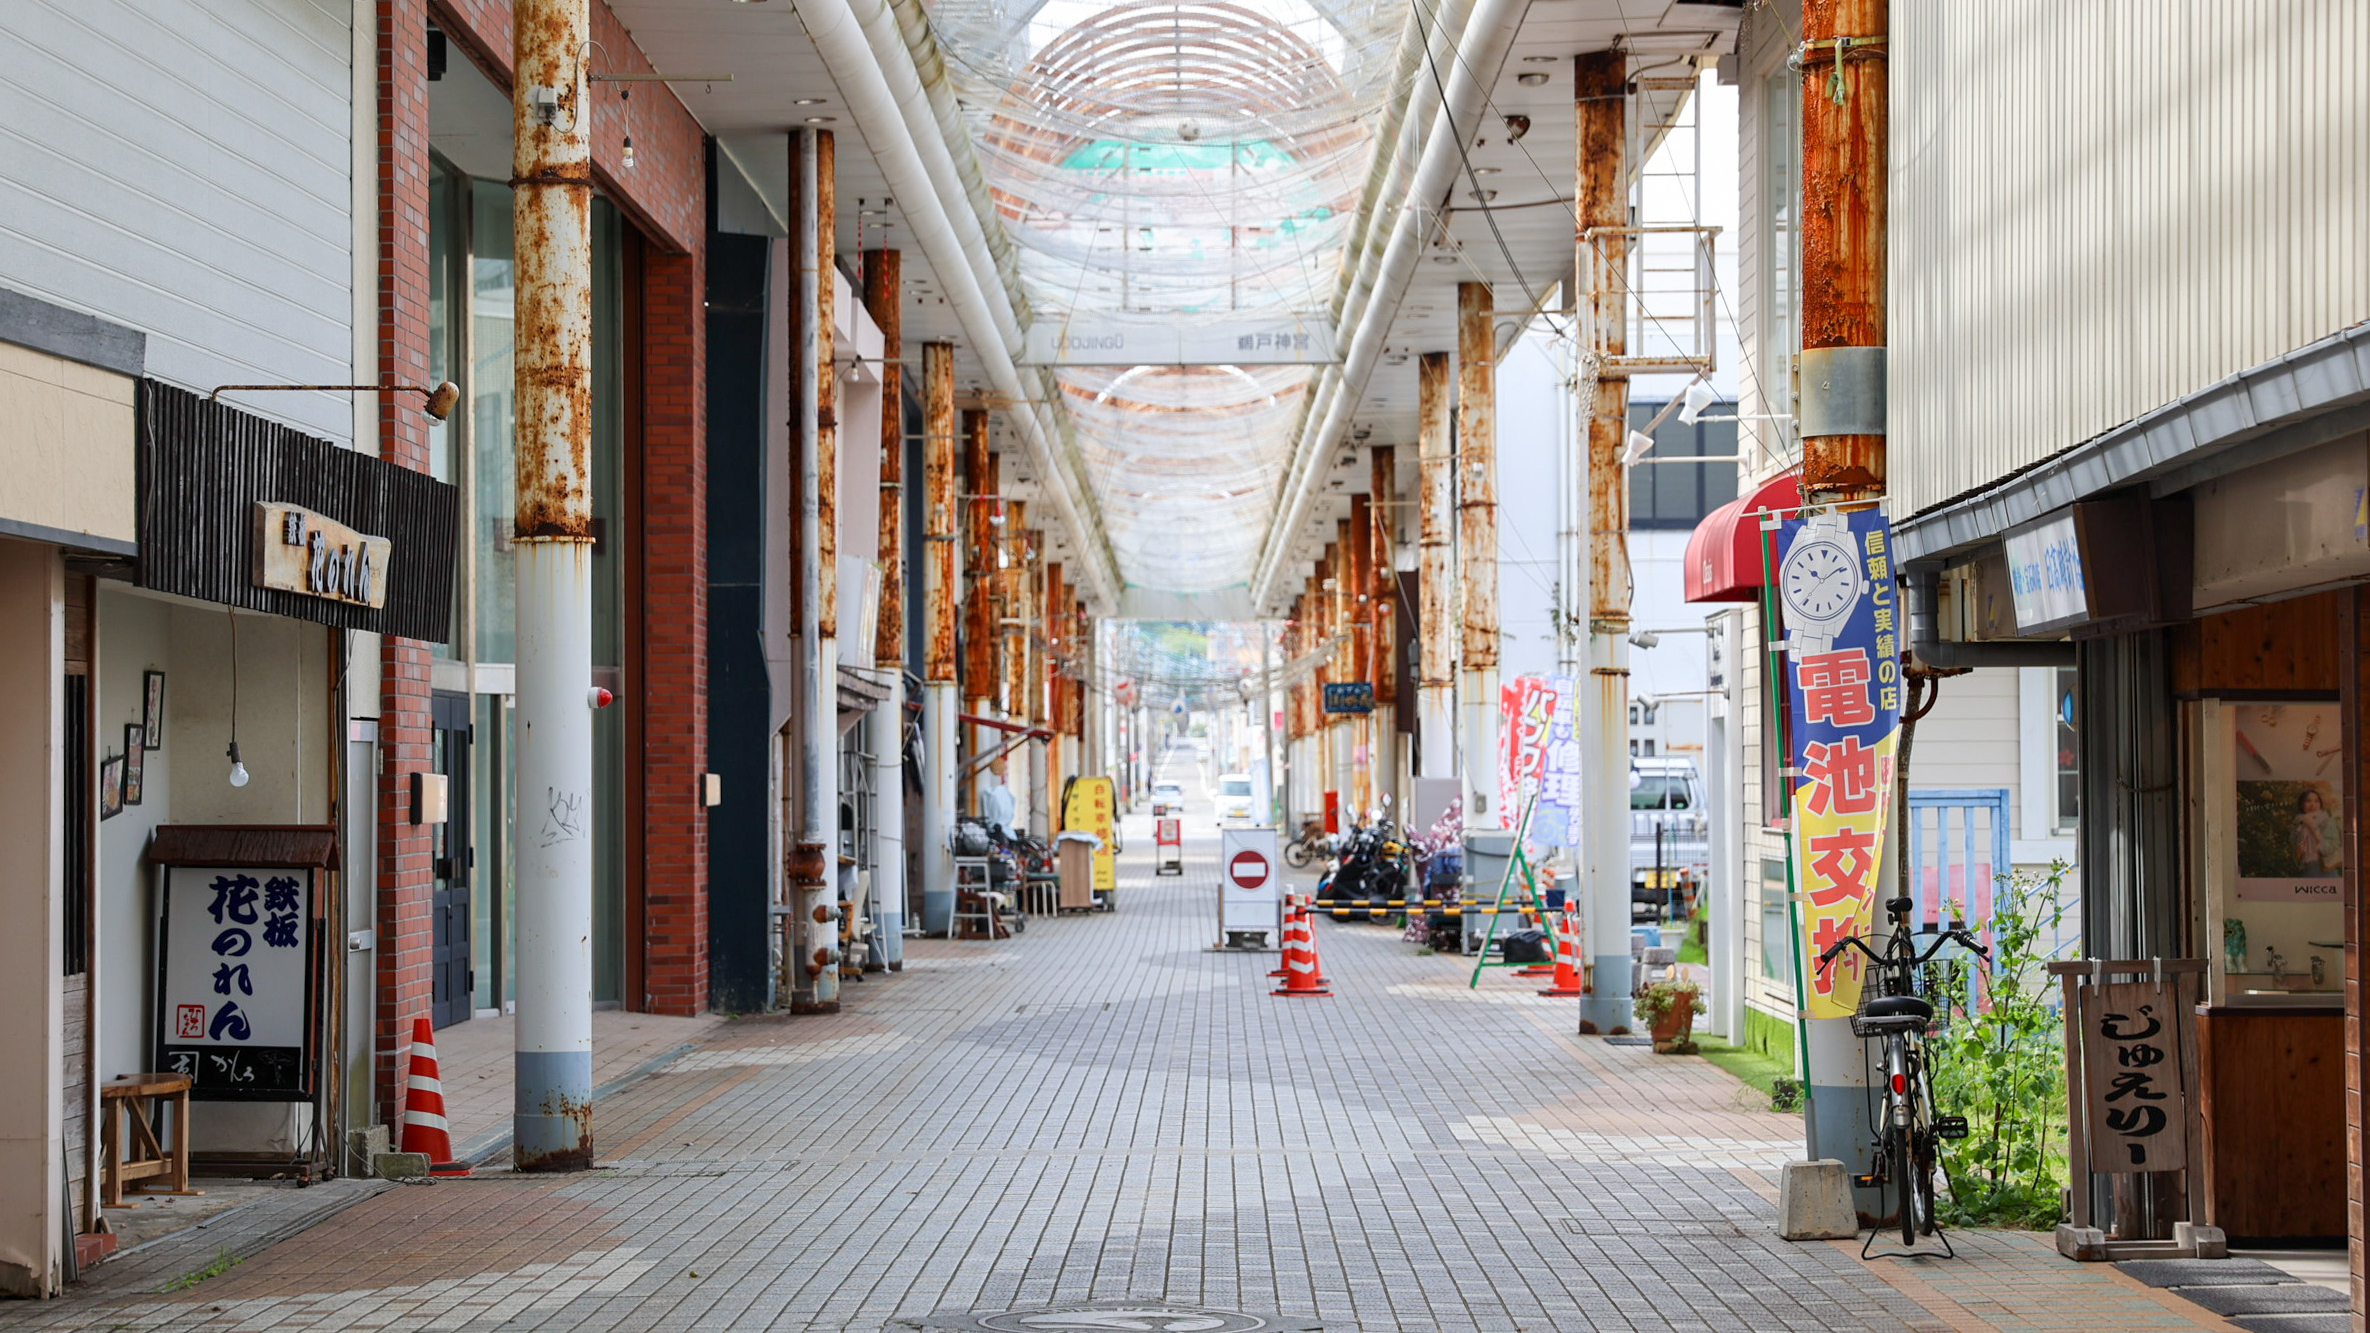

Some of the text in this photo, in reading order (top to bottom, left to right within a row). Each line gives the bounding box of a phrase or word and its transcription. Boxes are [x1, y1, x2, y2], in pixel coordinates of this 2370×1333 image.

[1864, 529, 1897, 711] 信頼と実績の店
[207, 874, 260, 1041] 花のれん
[263, 876, 300, 948] 鉄板
